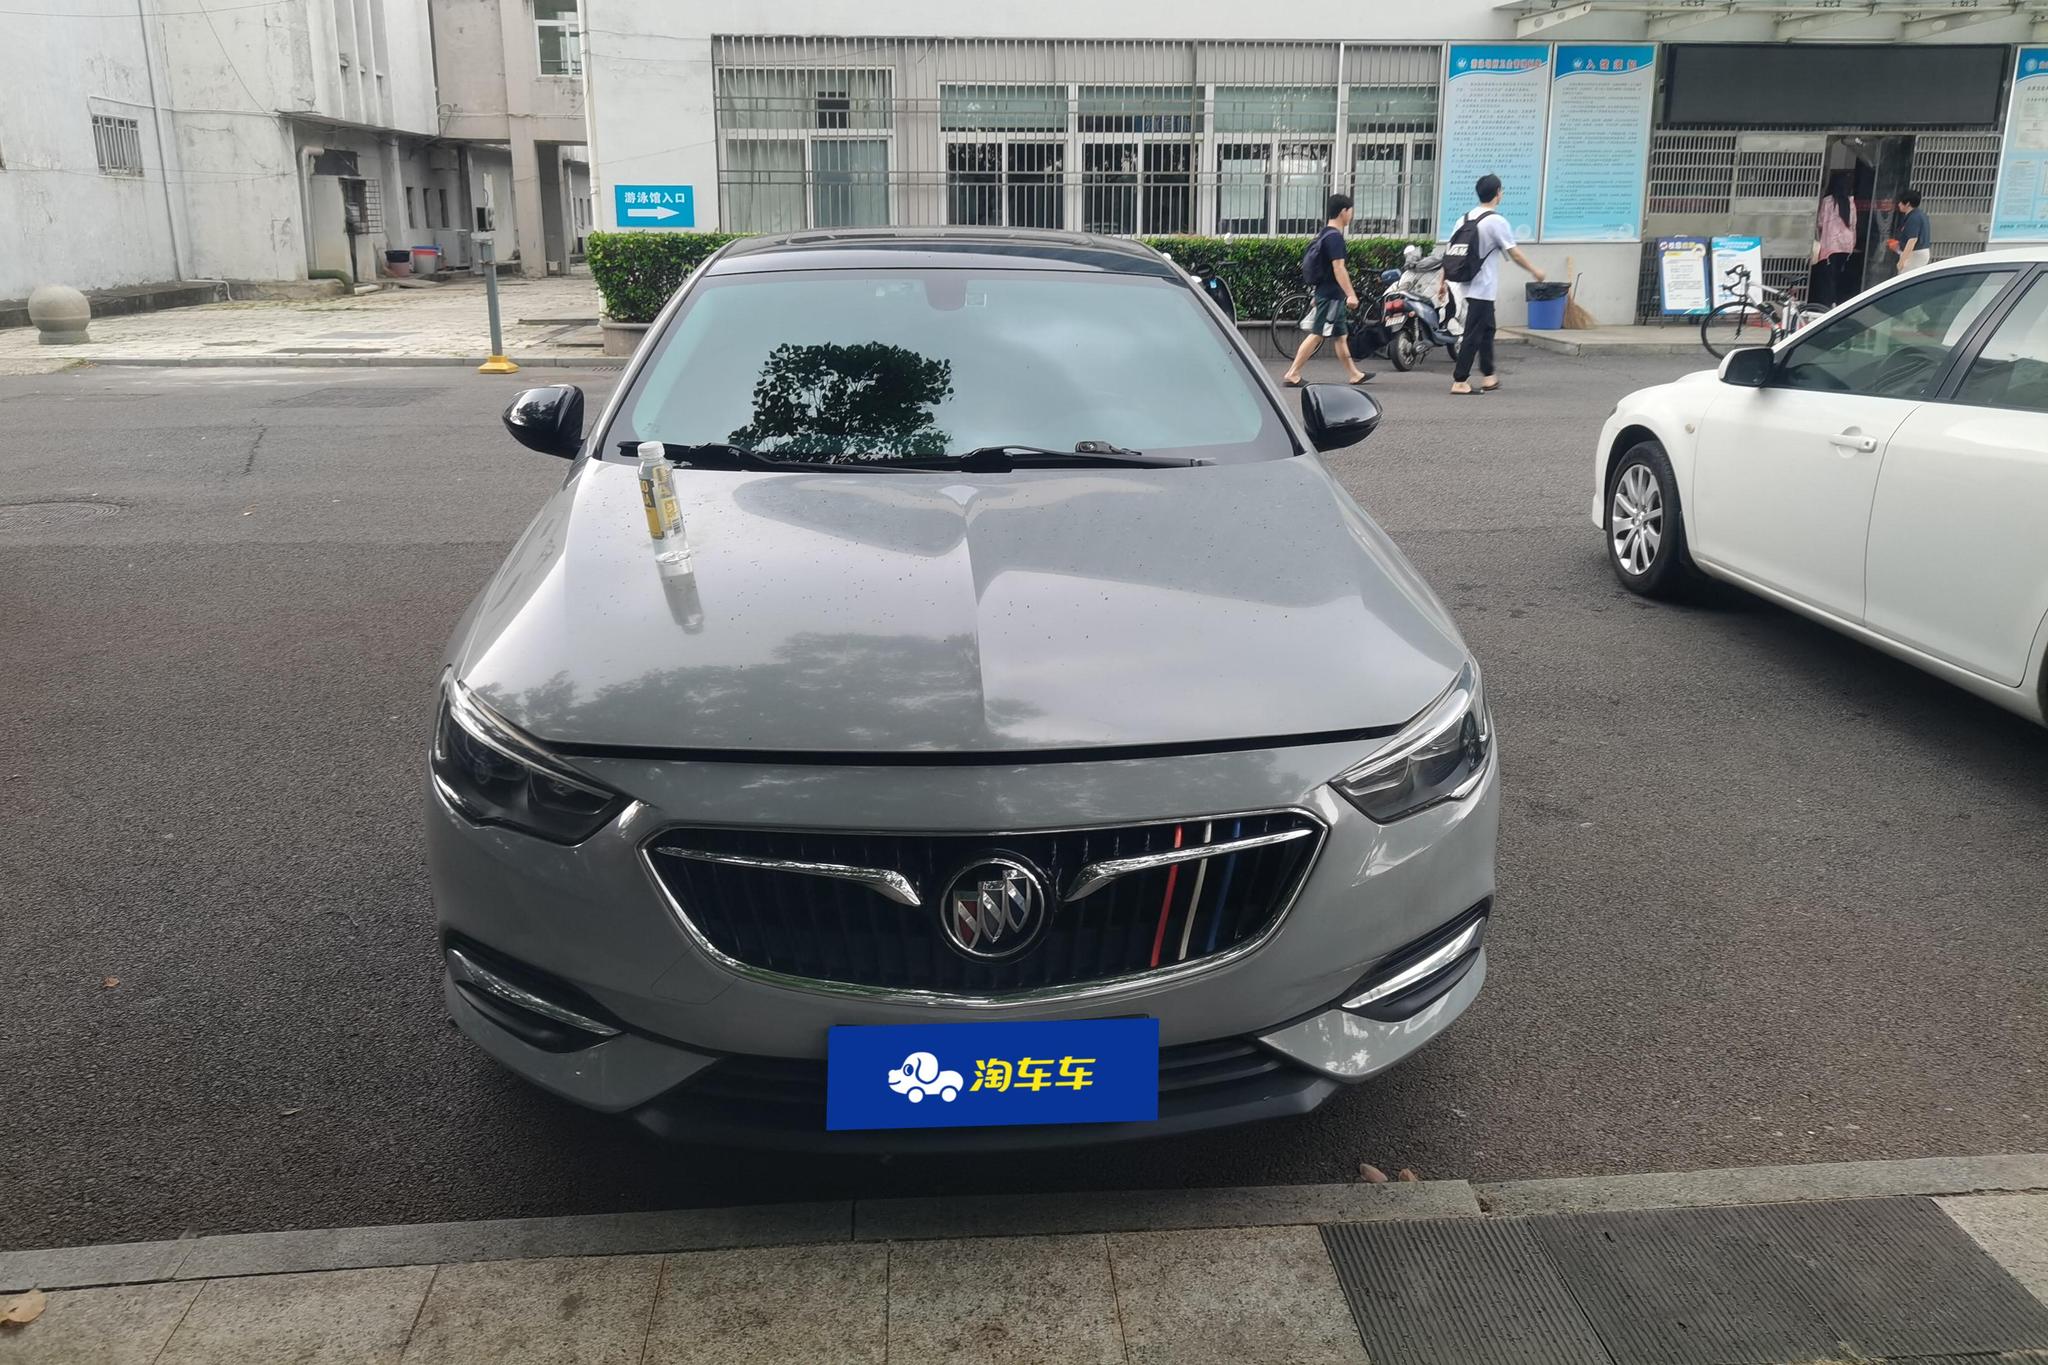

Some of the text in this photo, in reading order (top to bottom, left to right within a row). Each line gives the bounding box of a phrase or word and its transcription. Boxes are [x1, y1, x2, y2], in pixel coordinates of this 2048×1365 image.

[624, 191, 685, 204] 游泳馆入口
